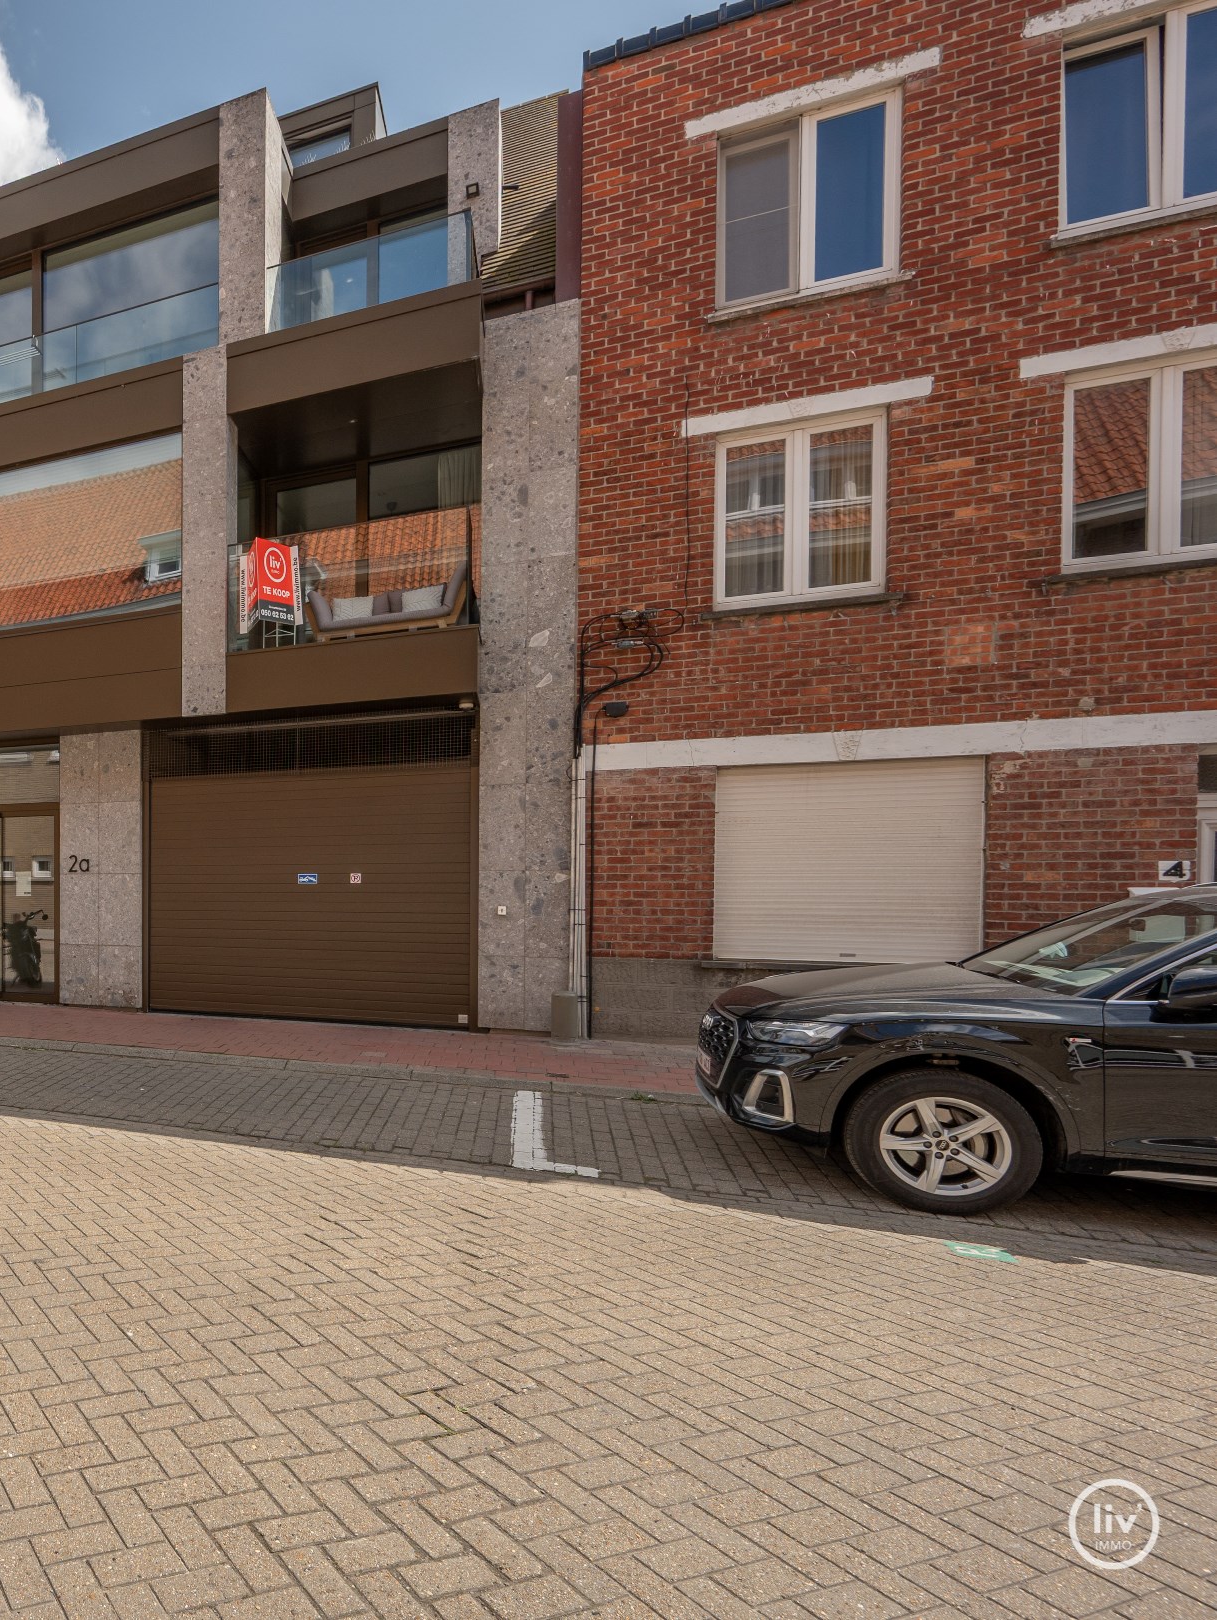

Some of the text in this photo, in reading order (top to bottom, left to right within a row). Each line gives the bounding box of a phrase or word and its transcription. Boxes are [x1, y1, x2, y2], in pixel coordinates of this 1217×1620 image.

[263, 586, 290, 598] TE KOOP
[261, 608, 271, 617] 050
[68, 855, 90, 872] 2a
[1162, 861, 1186, 878] 4
